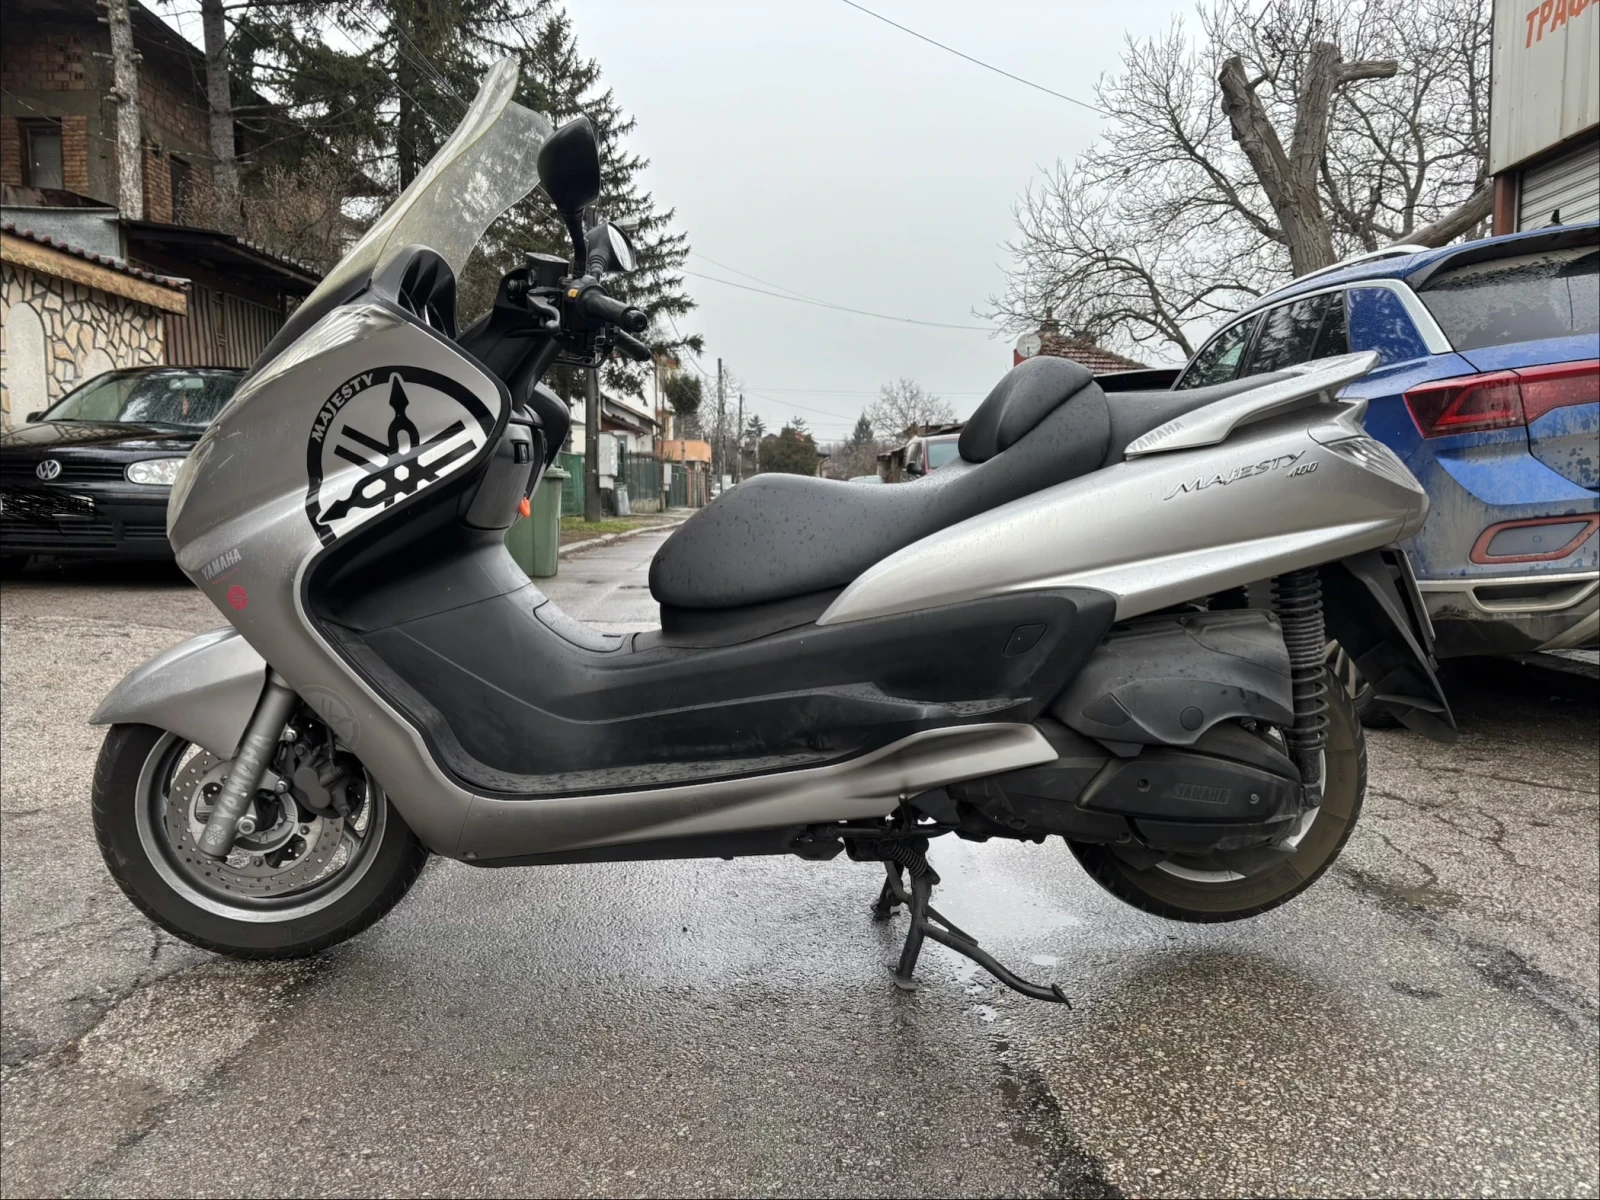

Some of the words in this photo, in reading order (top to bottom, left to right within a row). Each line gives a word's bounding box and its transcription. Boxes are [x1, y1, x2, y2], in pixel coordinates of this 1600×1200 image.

[1525, 0, 1599, 49] ТРАФ
[311, 373, 373, 443] MAJESTY
[1129, 421, 1185, 451] YAMAHA
[1163, 450, 1306, 501] MAJESTY
[1286, 461, 1319, 479] 400
[201, 548, 242, 580] YAMAHA
[1172, 783, 1231, 804] YAMAHA
